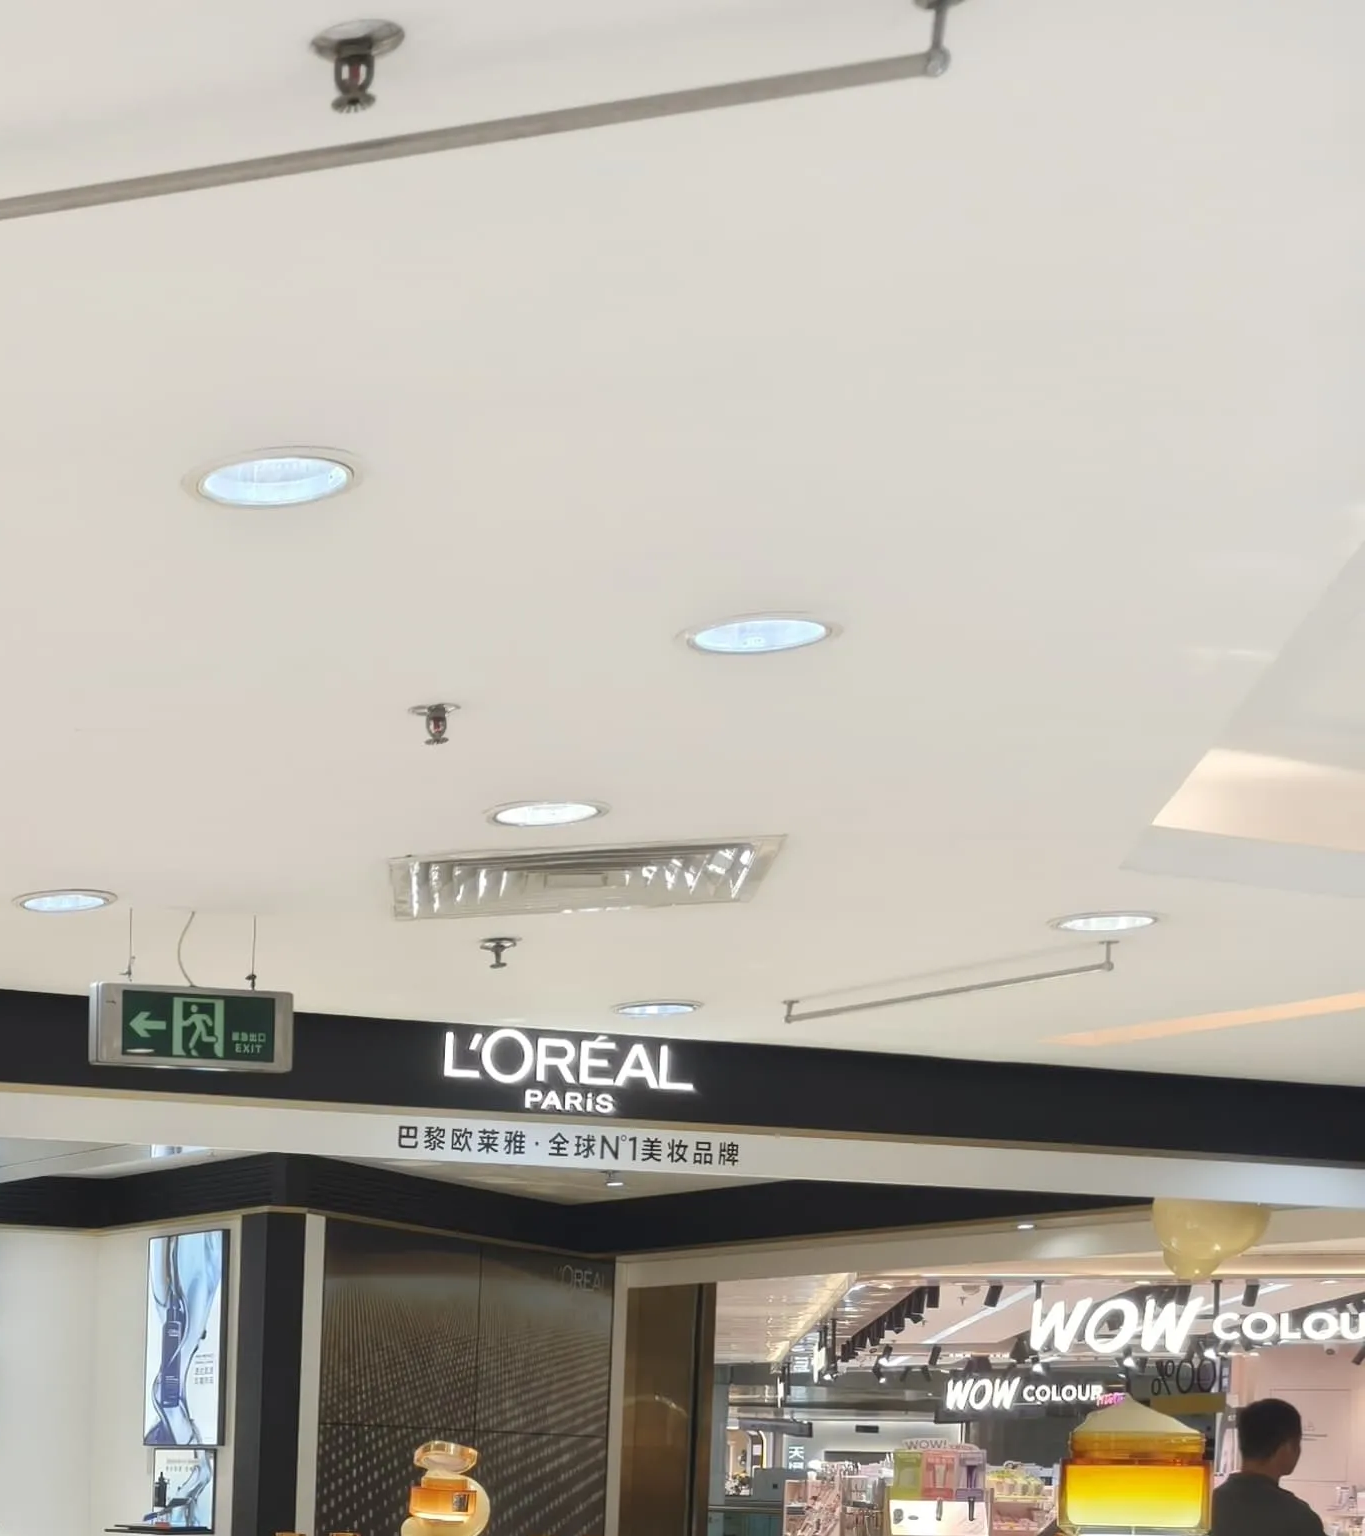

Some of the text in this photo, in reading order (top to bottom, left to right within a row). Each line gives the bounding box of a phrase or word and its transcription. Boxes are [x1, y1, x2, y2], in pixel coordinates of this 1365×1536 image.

[235, 1043, 263, 1053] EXIT
[443, 1029, 694, 1091] L'ORÉAL
[525, 1089, 615, 1114] PARiS
[1030, 1296, 1204, 1354] WOW
[945, 1376, 1021, 1411] WOW
[1022, 1384, 1103, 1402] COLOUR
